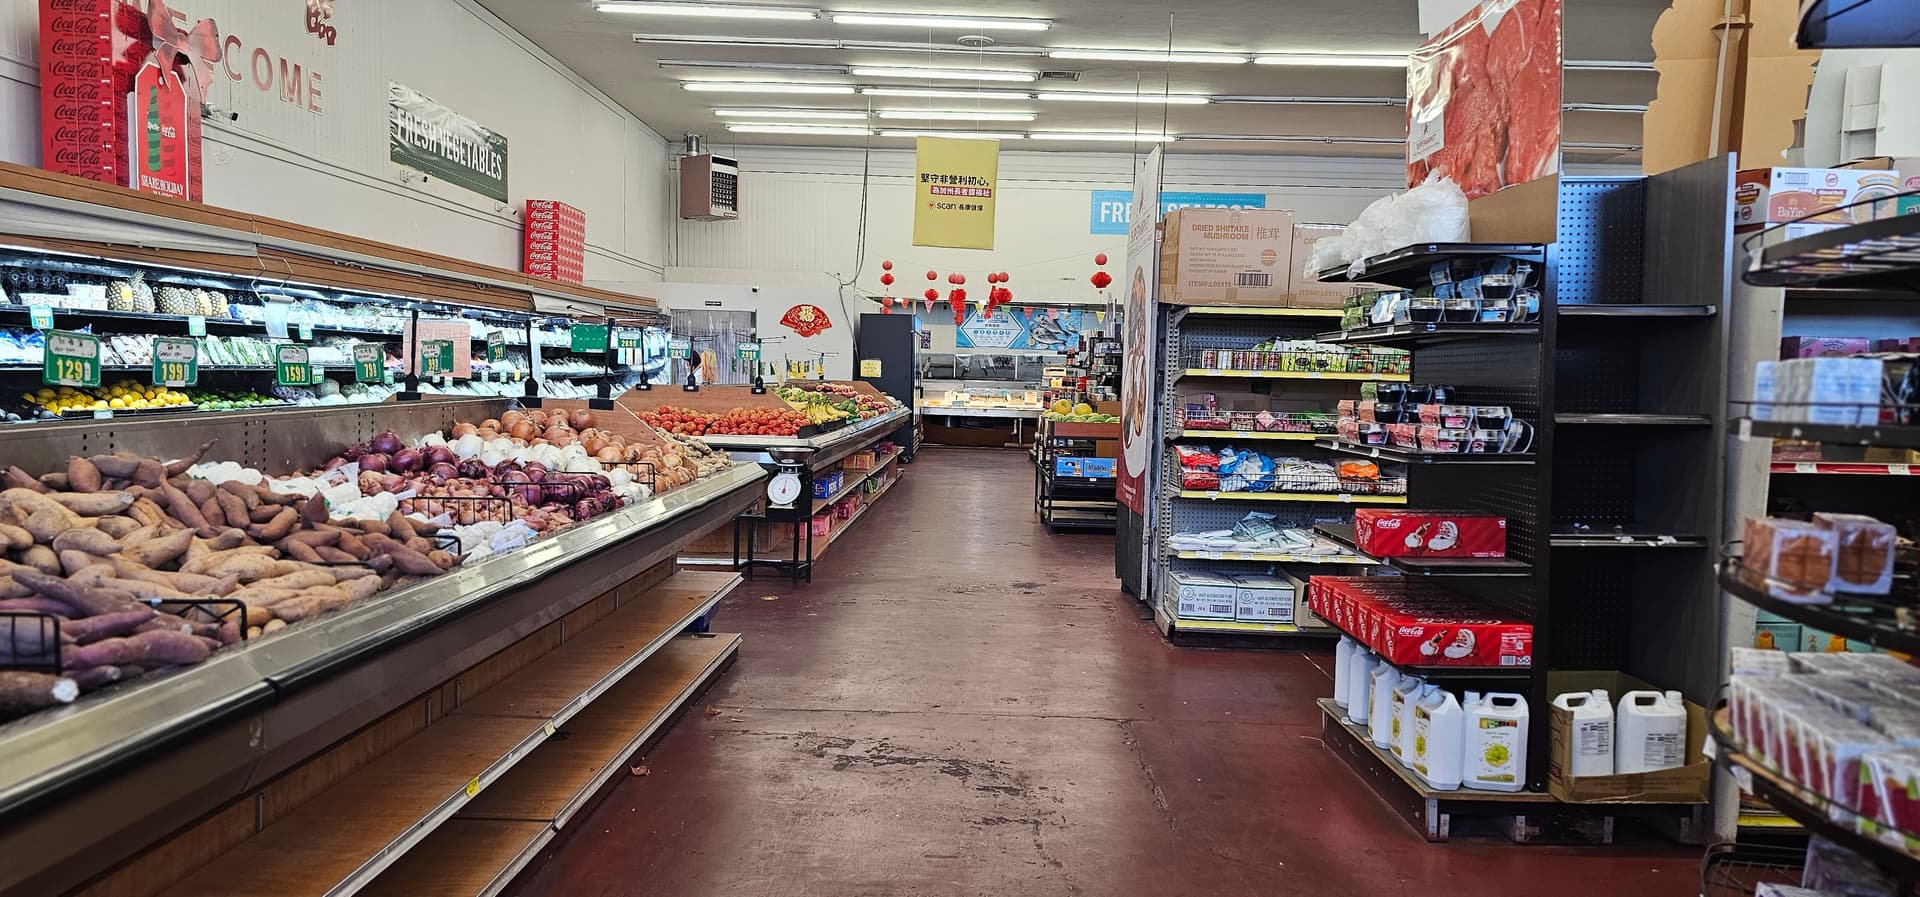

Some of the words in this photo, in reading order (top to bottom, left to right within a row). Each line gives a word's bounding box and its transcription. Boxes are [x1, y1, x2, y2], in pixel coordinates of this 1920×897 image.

[397, 108, 437, 153] FRESH
[439, 127, 502, 181] VEGETABLES
[1192, 224, 1214, 232] DRIED
[1215, 225, 1249, 233] SHIITAKE
[1203, 232, 1249, 240] MUSHROOM
[57, 359, 83, 380] 129
[162, 363, 183, 381] 199
